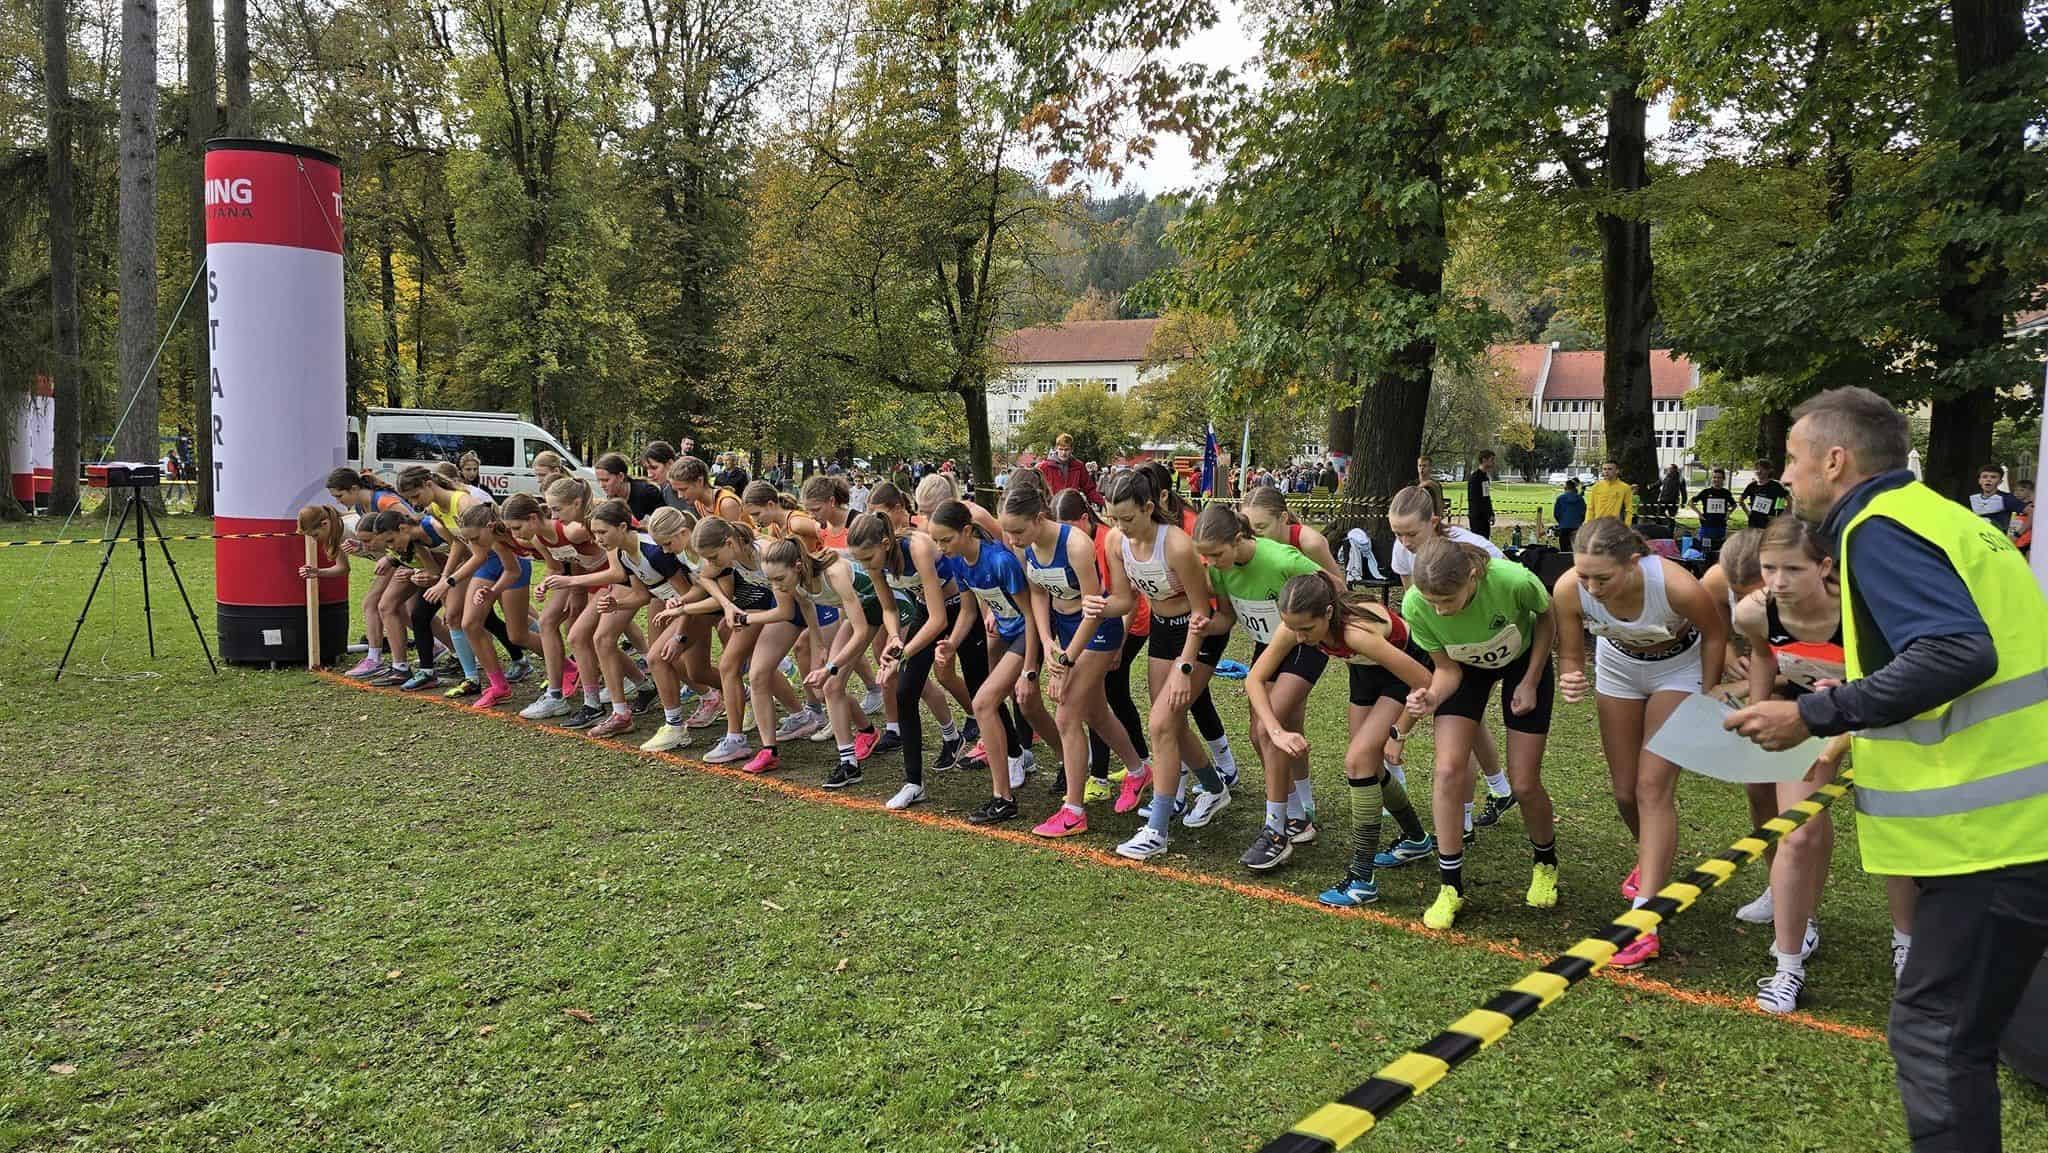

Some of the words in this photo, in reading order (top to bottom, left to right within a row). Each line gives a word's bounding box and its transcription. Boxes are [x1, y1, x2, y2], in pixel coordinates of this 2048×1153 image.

[208, 270, 224, 492] START
[1240, 612, 1269, 633] 201
[1468, 646, 1511, 664] 202
